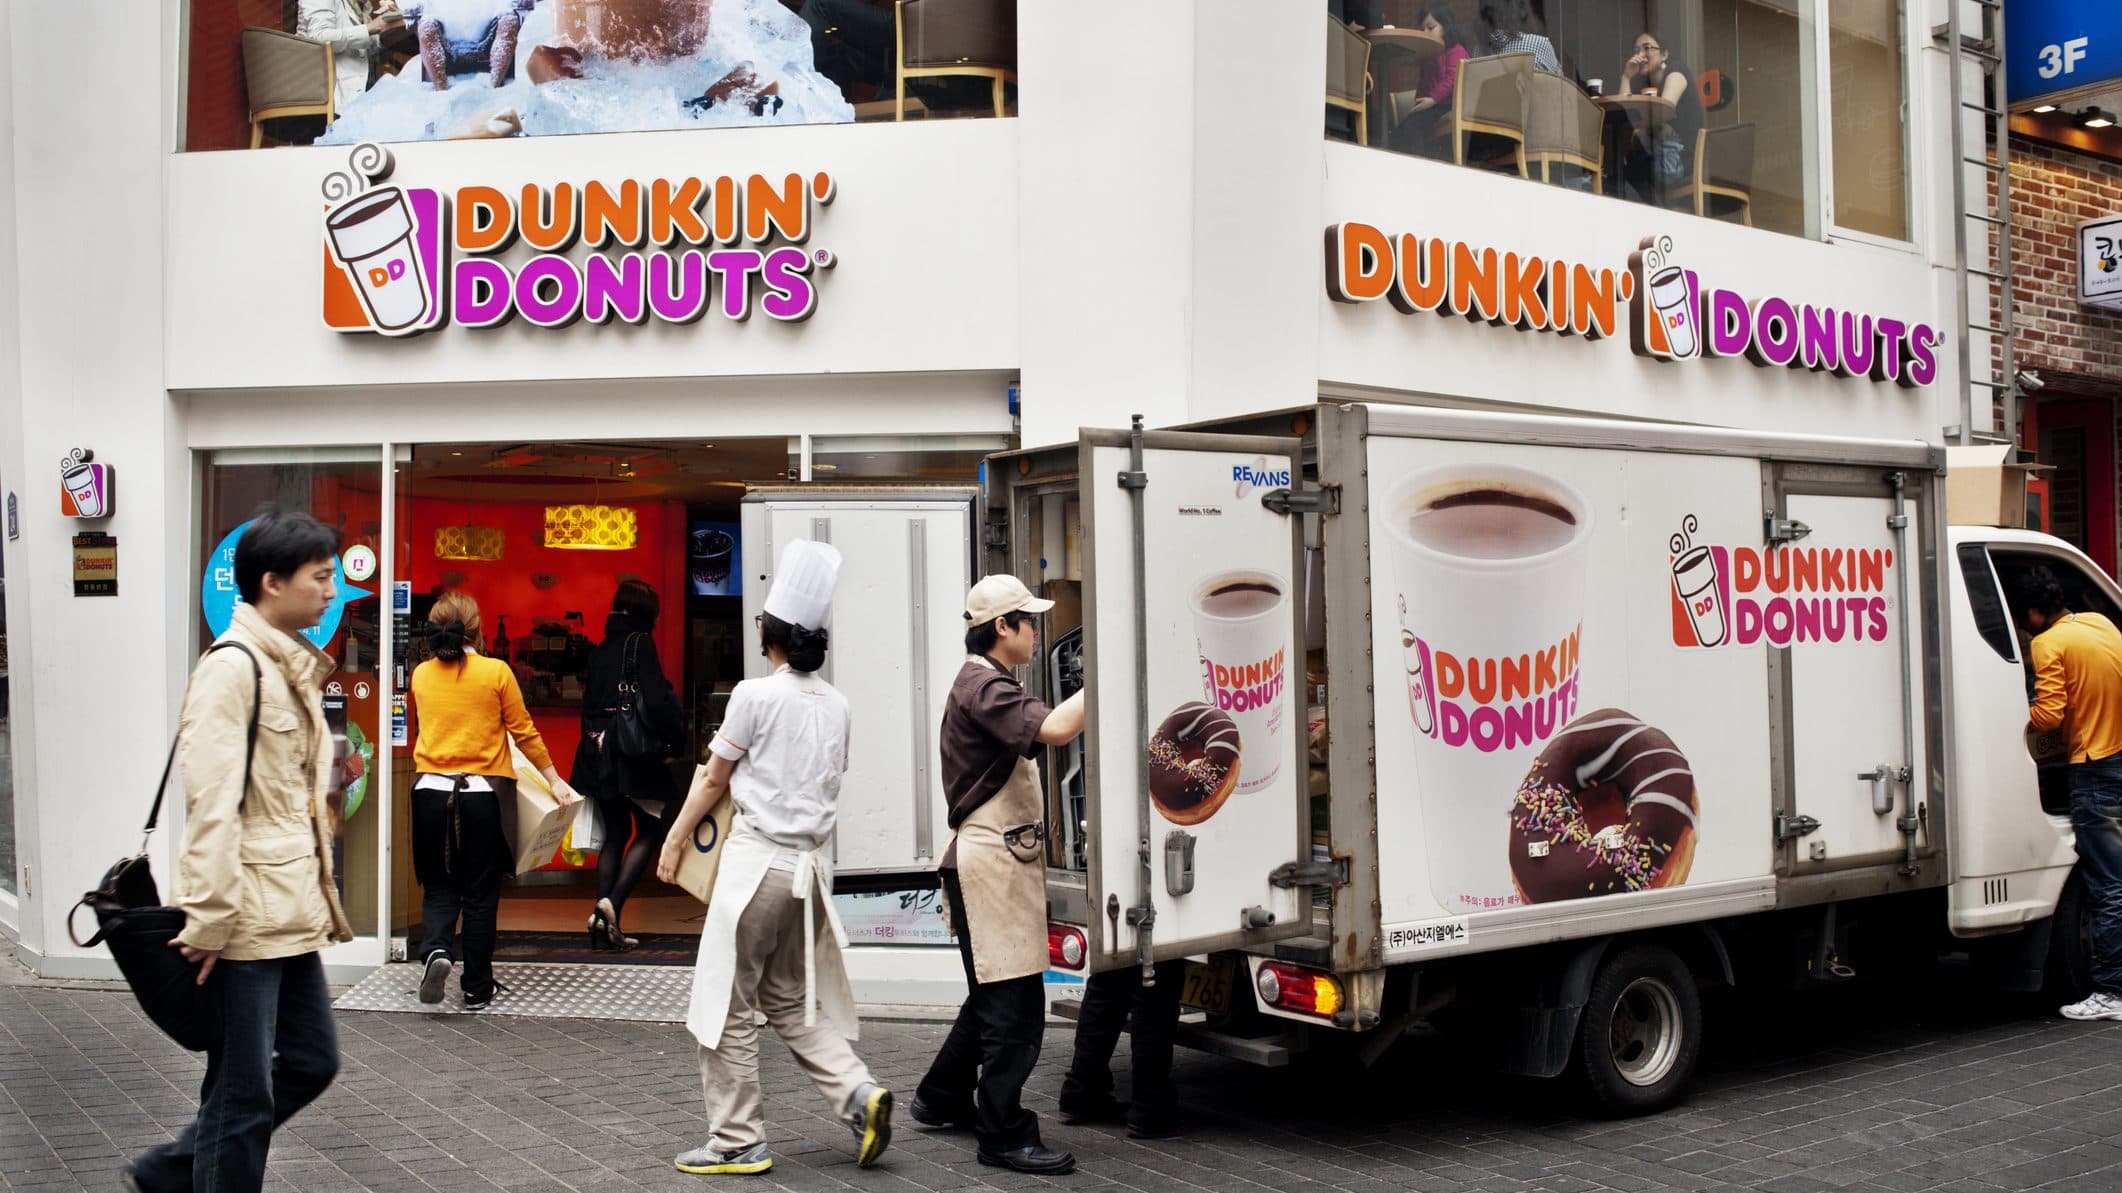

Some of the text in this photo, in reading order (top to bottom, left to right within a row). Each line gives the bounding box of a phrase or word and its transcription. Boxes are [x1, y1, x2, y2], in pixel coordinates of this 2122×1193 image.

[2038, 36, 2088, 79] 3F
[455, 170, 836, 250] DUNKIN'
[368, 258, 405, 289] DD
[1343, 222, 1634, 338] DUNKIN'
[1668, 311, 1685, 328] DD
[1233, 466, 1289, 486] REVANS
[78, 490, 91, 502] DD
[1734, 547, 1893, 593] DUNKIN'
[1694, 596, 1713, 617] DD
[1440, 667, 1579, 752] DONUTS
[1389, 923, 1464, 948] (주)아산지엘에스
